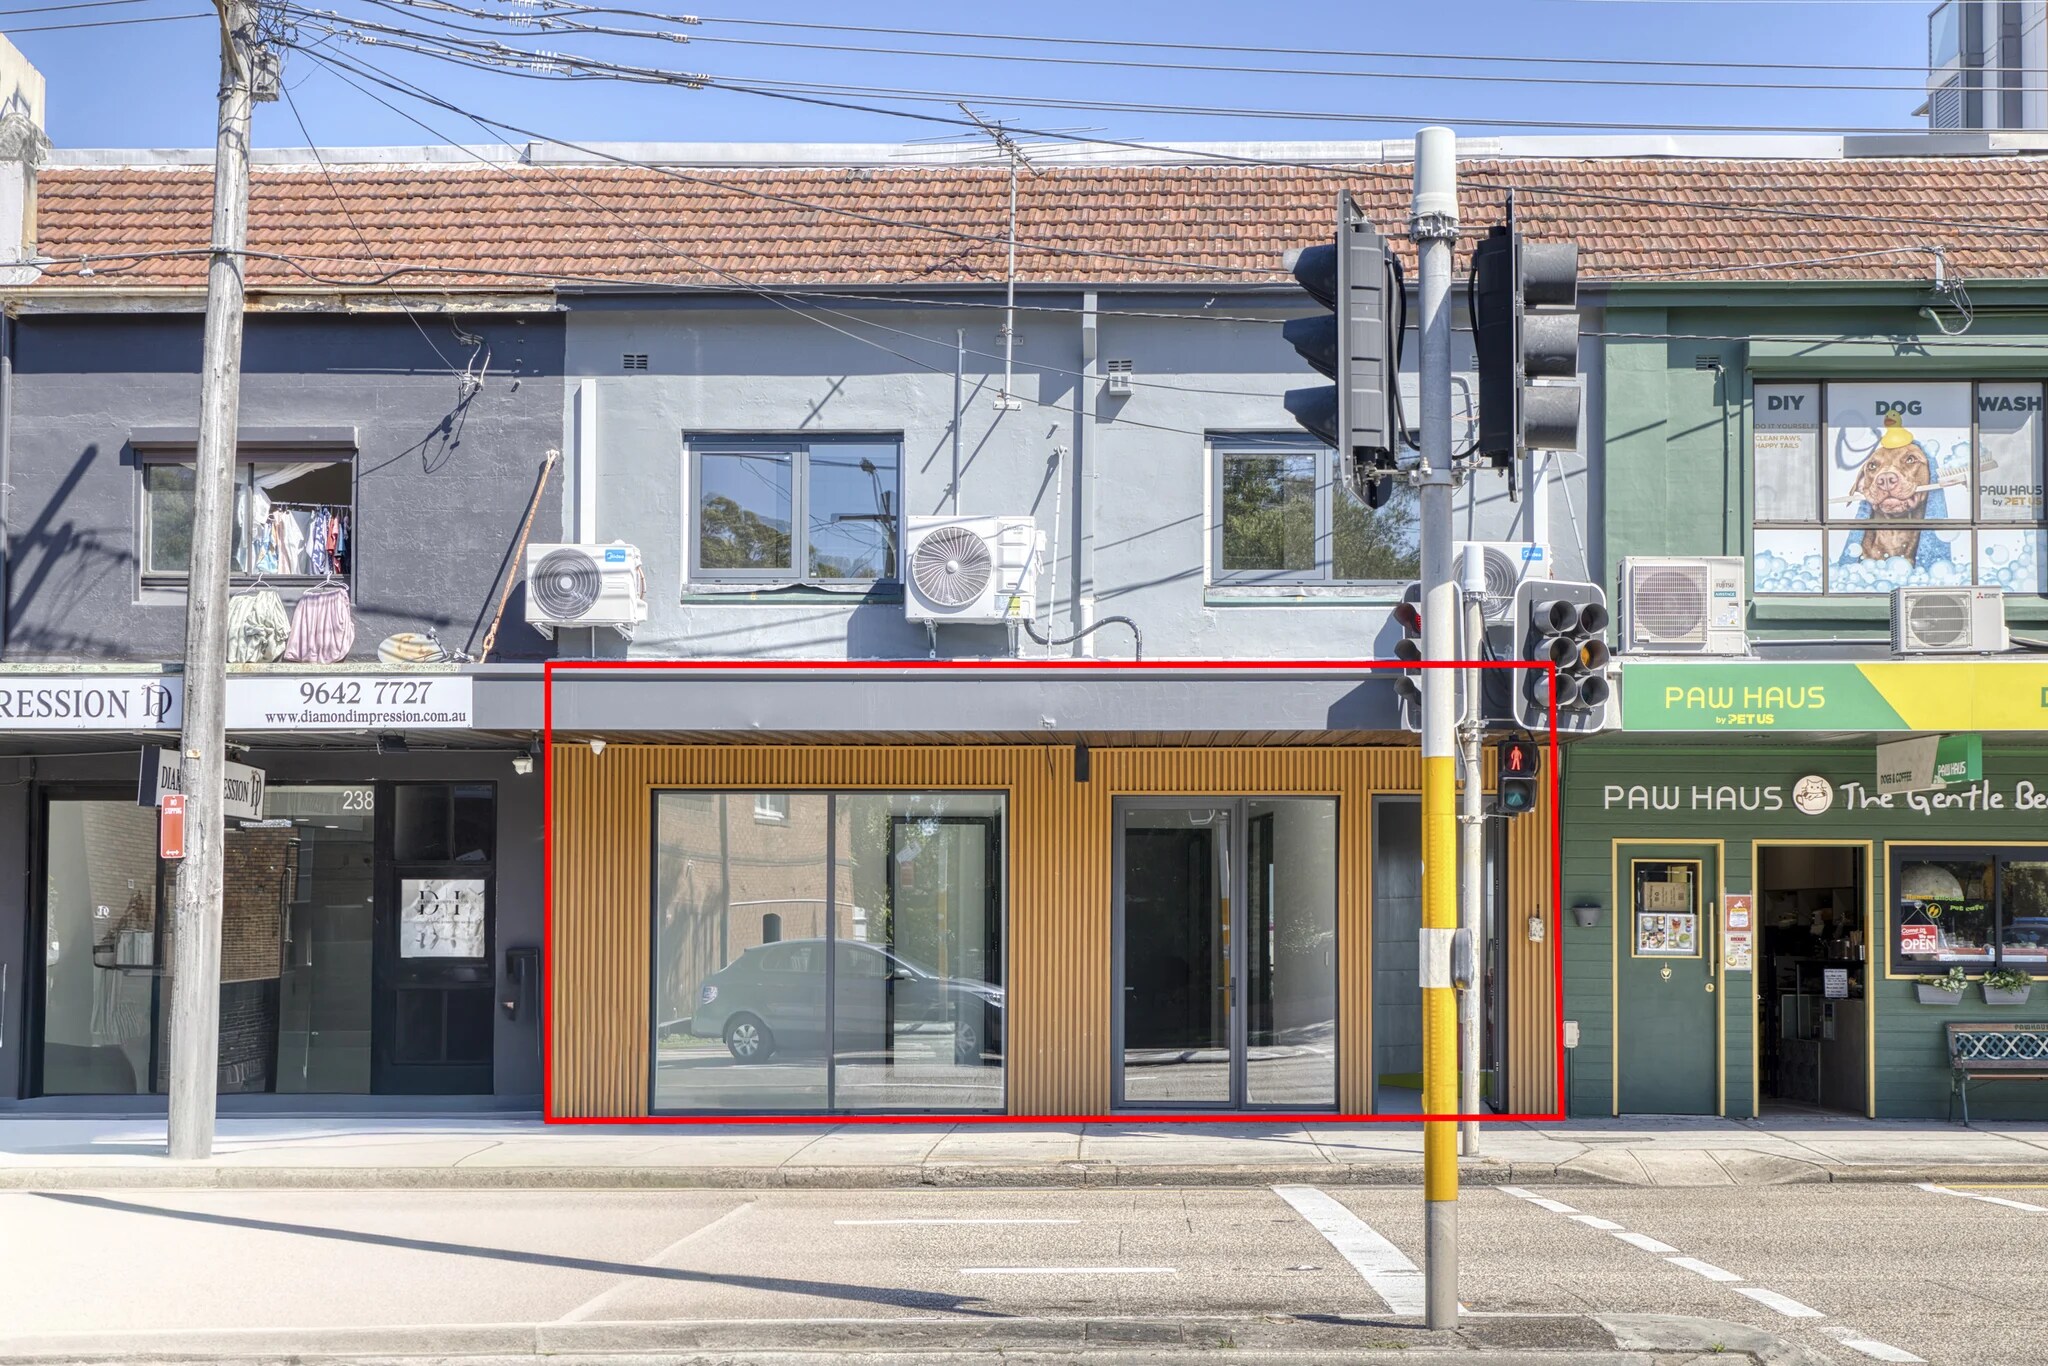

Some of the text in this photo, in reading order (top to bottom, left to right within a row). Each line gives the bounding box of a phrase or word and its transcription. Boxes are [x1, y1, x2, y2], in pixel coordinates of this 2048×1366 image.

[1768, 395, 2042, 415] DIY DOG WASH
[1980, 485, 2042, 495] PAW HAUS
[1992, 498, 2002, 506] by
[299, 681, 433, 705] 9642 7727
[1665, 686, 1826, 709] PAW HAUS
[265, 709, 467, 726] www.diamondimpression.com.au
[1715, 713, 1775, 725] by PET US
[342, 790, 375, 810] 238
[1604, 779, 2048, 816] PAW HAUS The Gentle Be
[1901, 938, 1936, 950] OPEN
